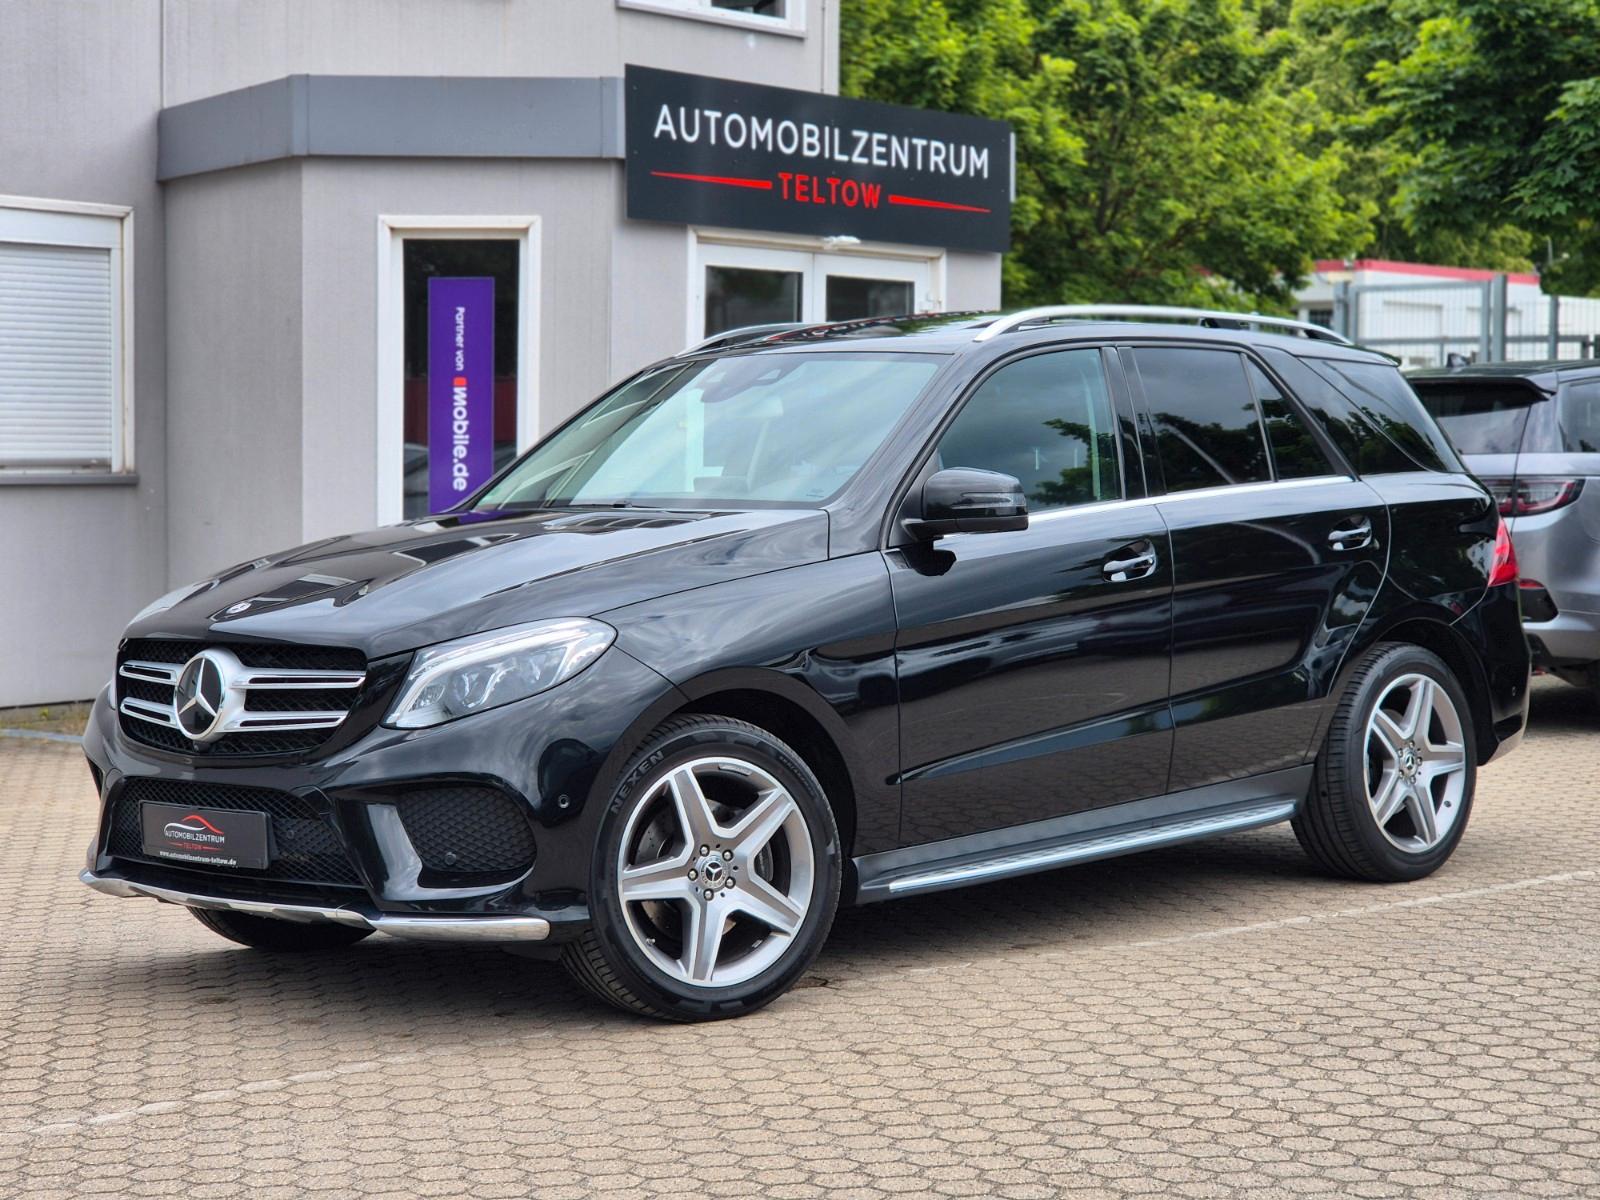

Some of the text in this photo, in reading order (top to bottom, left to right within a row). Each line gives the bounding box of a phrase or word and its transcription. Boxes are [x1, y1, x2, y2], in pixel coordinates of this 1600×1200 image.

[654, 105, 989, 179] AUTOMOBILZENTRUM
[778, 172, 881, 209] TELTOW
[452, 307, 470, 491] Partner von mobile.de
[611, 751, 664, 813] NEXEN
[165, 831, 224, 843] AUTOMOBILZENTRUM
